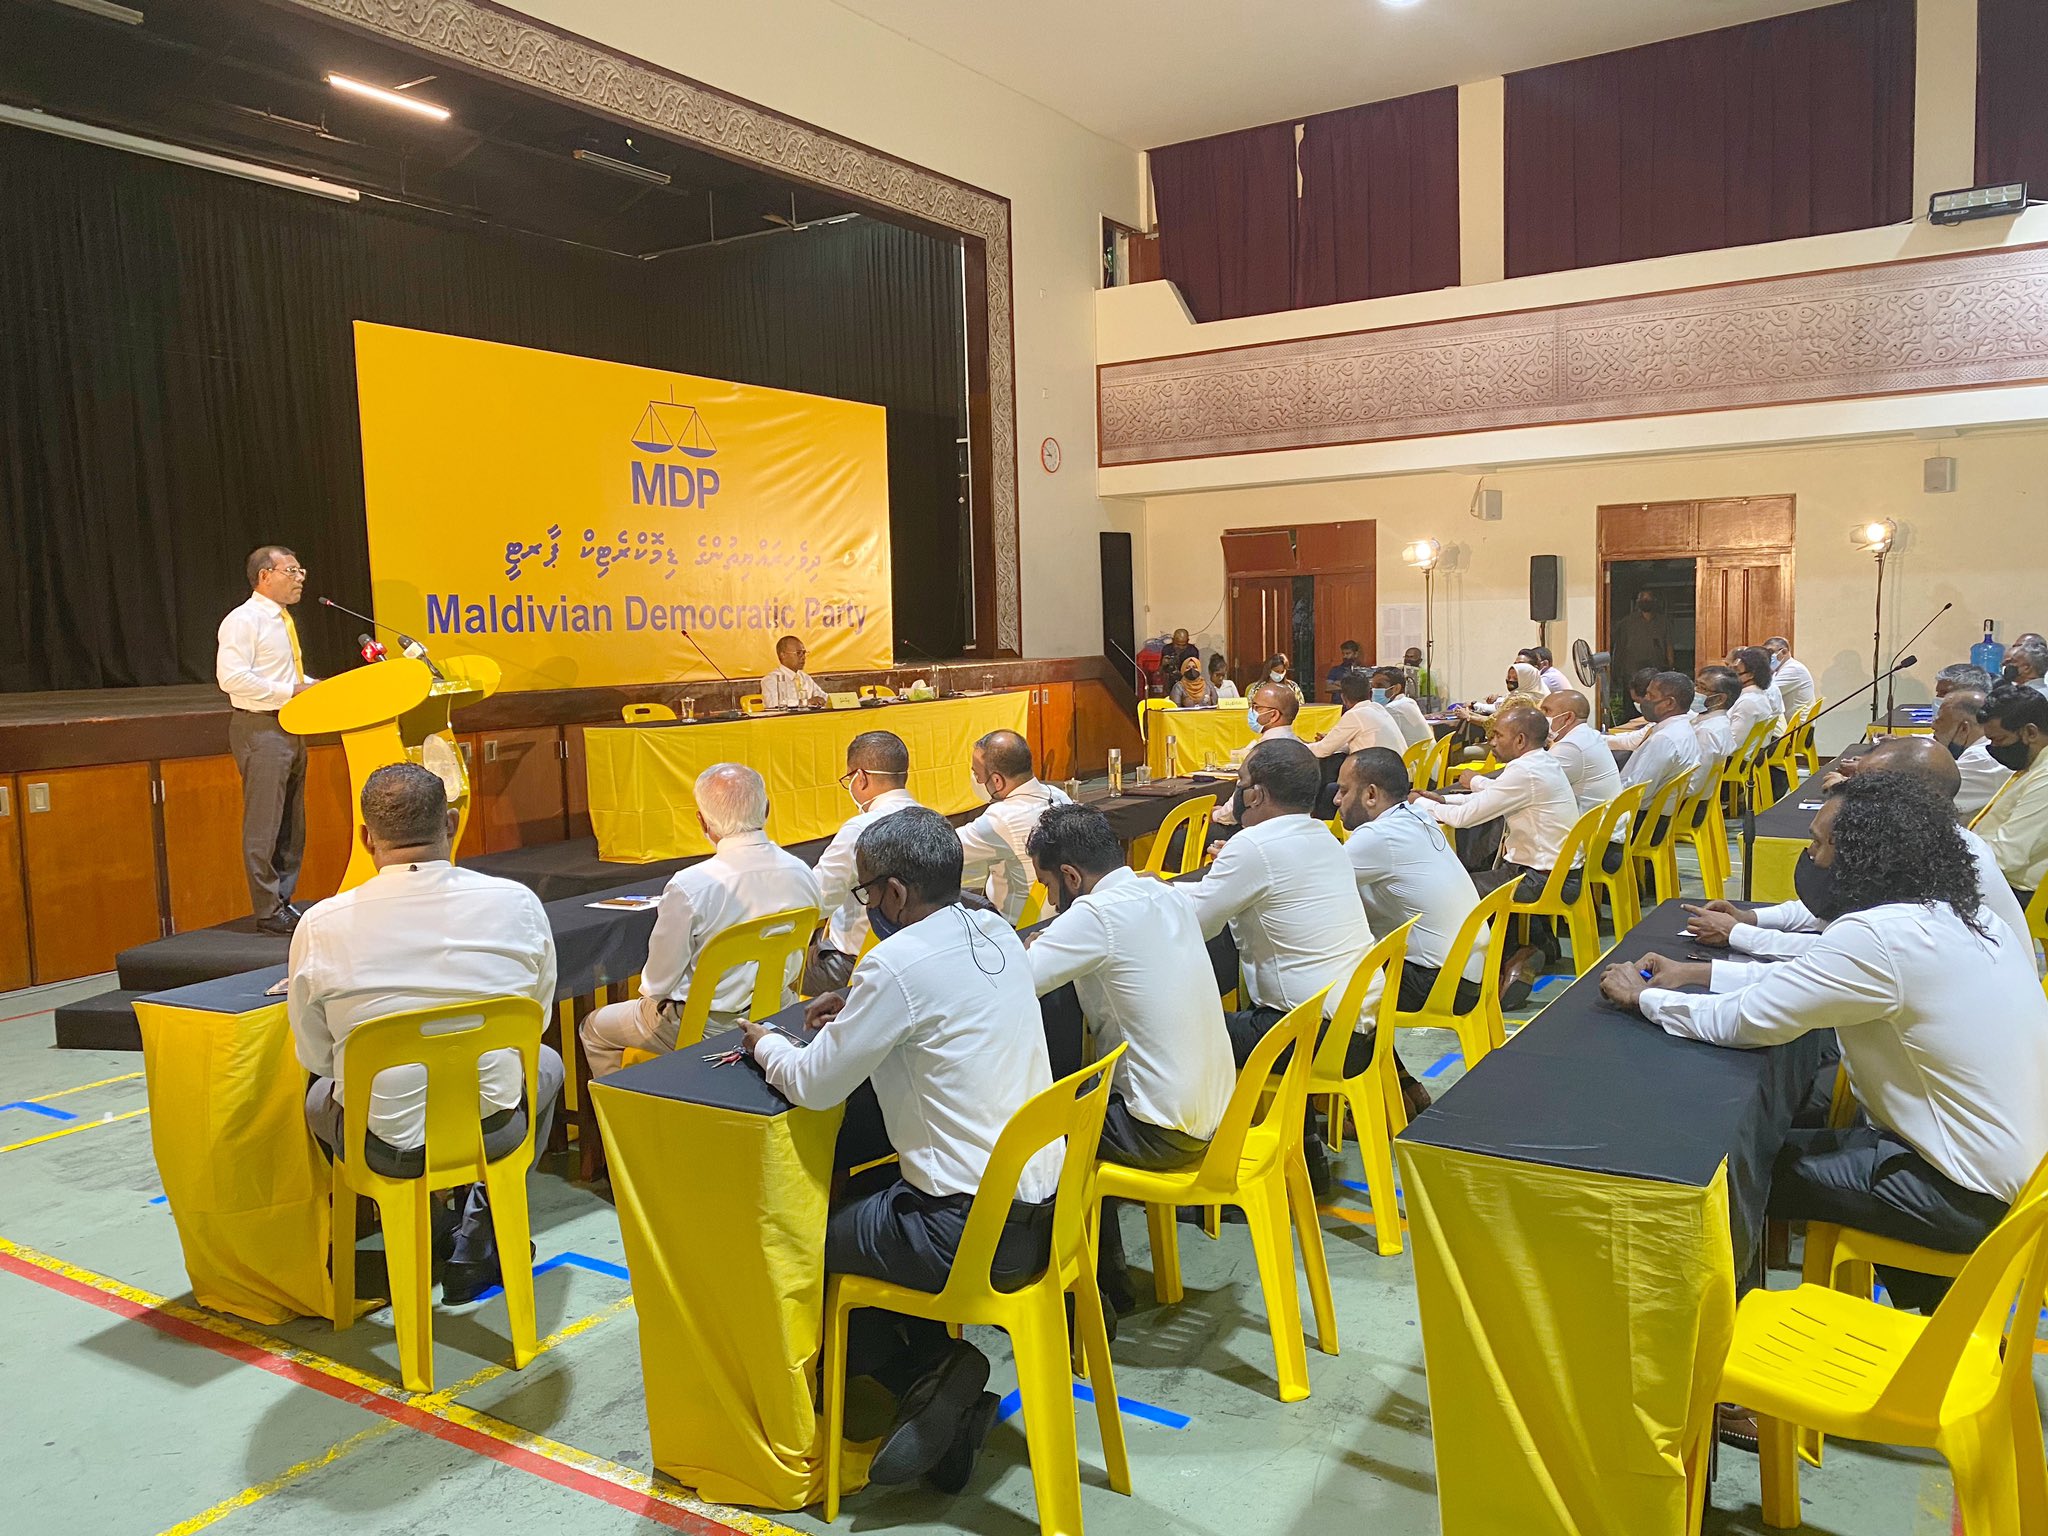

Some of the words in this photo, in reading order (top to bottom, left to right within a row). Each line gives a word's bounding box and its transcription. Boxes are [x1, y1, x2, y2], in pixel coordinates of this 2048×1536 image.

[631, 460, 720, 509] MDP
[505, 523, 562, 581] ޕާރޓީ
[580, 528, 678, 580] ޑިމޮކްރެޓިކް
[427, 593, 613, 634] Maldivian
[625, 595, 796, 631] Democratic
[805, 597, 867, 635] Party
